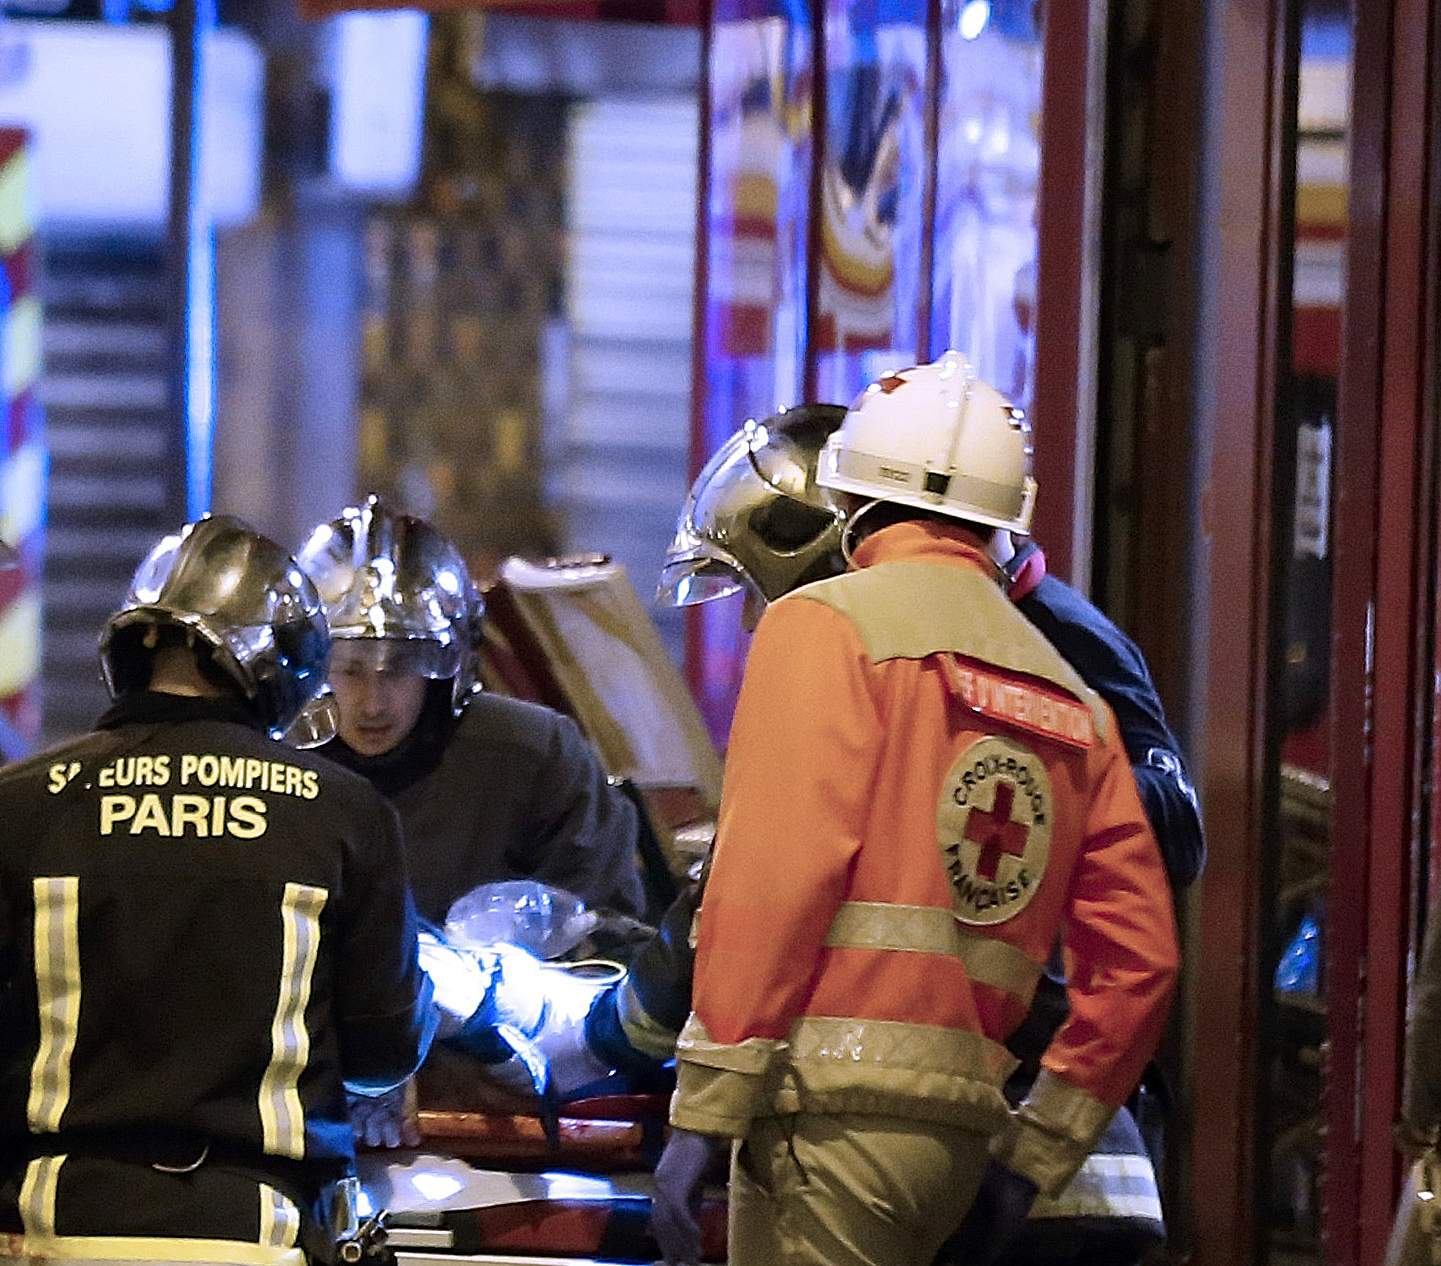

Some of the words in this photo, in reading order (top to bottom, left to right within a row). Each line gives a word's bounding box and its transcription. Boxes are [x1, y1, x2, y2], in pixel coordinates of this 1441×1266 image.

[46, 754, 171, 795] SEURS
[179, 754, 320, 800] POMPIERS
[99, 793, 268, 840] PARIS
